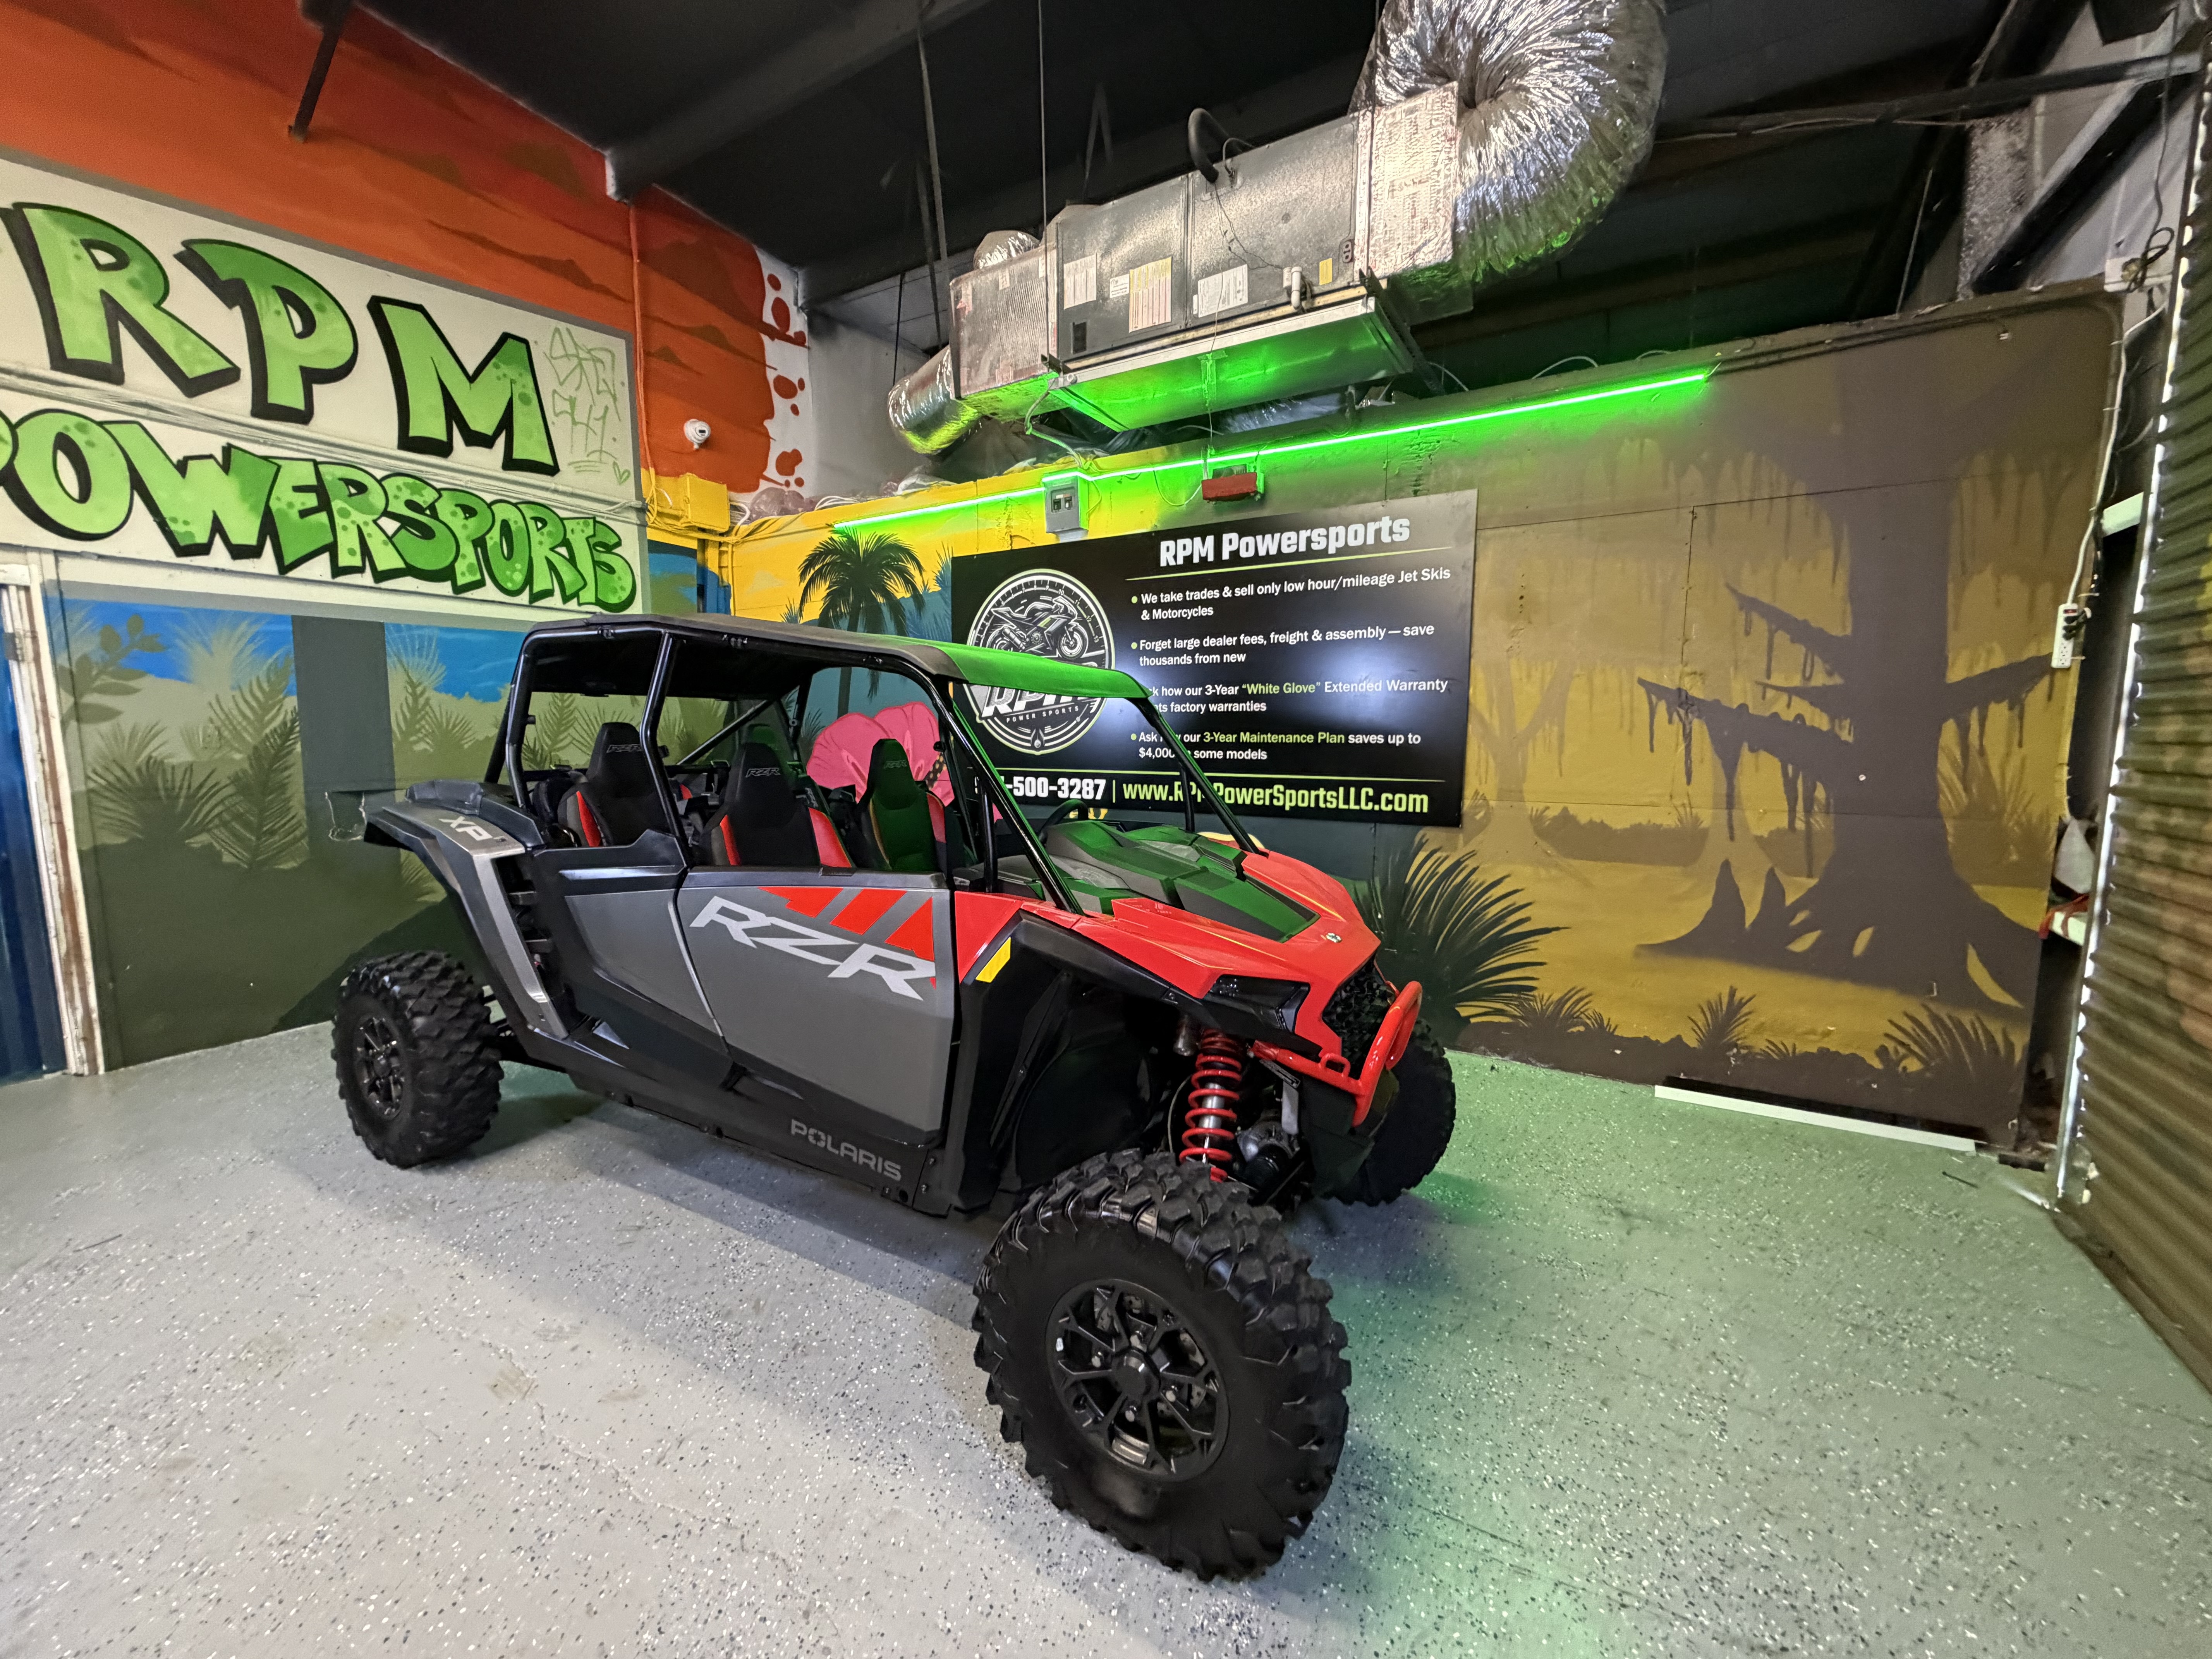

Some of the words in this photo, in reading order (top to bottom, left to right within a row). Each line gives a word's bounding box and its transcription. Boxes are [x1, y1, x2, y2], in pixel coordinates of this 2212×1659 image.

[0, 202, 561, 477] RPM
[1160, 535, 1214, 567] RPM
[1222, 515, 1410, 560] Powersports
[1141, 593, 1158, 604] We
[1160, 591, 1183, 602] take
[1186, 588, 1220, 601] trades
[1222, 586, 1232, 598] &
[1234, 584, 1254, 596] sell
[1257, 582, 1281, 596] only
[1284, 581, 1305, 592] low
[1308, 573, 1395, 591] hour/mileage
[1398, 570, 1418, 583] Jet
[1420, 567, 1451, 581] Skis
[1141, 610, 1150, 620] &
[1152, 605, 1214, 620] Motorcycles
[1140, 639, 1171, 651] Forget
[1174, 637, 1200, 650] large
[1202, 635, 1237, 647] dealer
[1240, 634, 1267, 646] fees,
[1269, 630, 1309, 645] freight
[1311, 629, 1322, 641] &
[1325, 626, 1386, 641] assembly
[1403, 625, 1435, 637] save
[1139, 654, 1192, 666] thousands
[1194, 653, 1220, 664] from
[1223, 652, 1246, 663] new
[1162, 686, 1182, 696] how
[1185, 687, 1202, 696] our
[1205, 684, 1239, 696] 3-Year
[1242, 683, 1280, 694] “White
[1283, 682, 1321, 694] Glove”
[1324, 680, 1382, 693] Extended
[1386, 678, 1448, 693] Warranty
[1006, 713, 1036, 723] POWER
[1042, 706, 1079, 717] SPORTS
[1170, 702, 1206, 714] factory
[1209, 700, 1267, 713] warranties
[1139, 732, 1158, 742] Ask
[1183, 734, 1201, 742] our
[1203, 732, 1238, 743] 3-Year
[1240, 732, 1314, 744] Maintenance
[1317, 731, 1345, 744] Plan
[1348, 734, 1384, 745] saves
[1388, 734, 1405, 747] up
[1408, 732, 1421, 745] to
[1194, 749, 1224, 759] some
[1226, 748, 1267, 760] models
[974, 776, 1106, 800] -500-3287
[1123, 781, 1429, 813] www.RPowerSportsLLC.com
[438, 816, 493, 841] XP
[689, 896, 936, 1001] RZR
[791, 1118, 902, 1182] POLARIS
